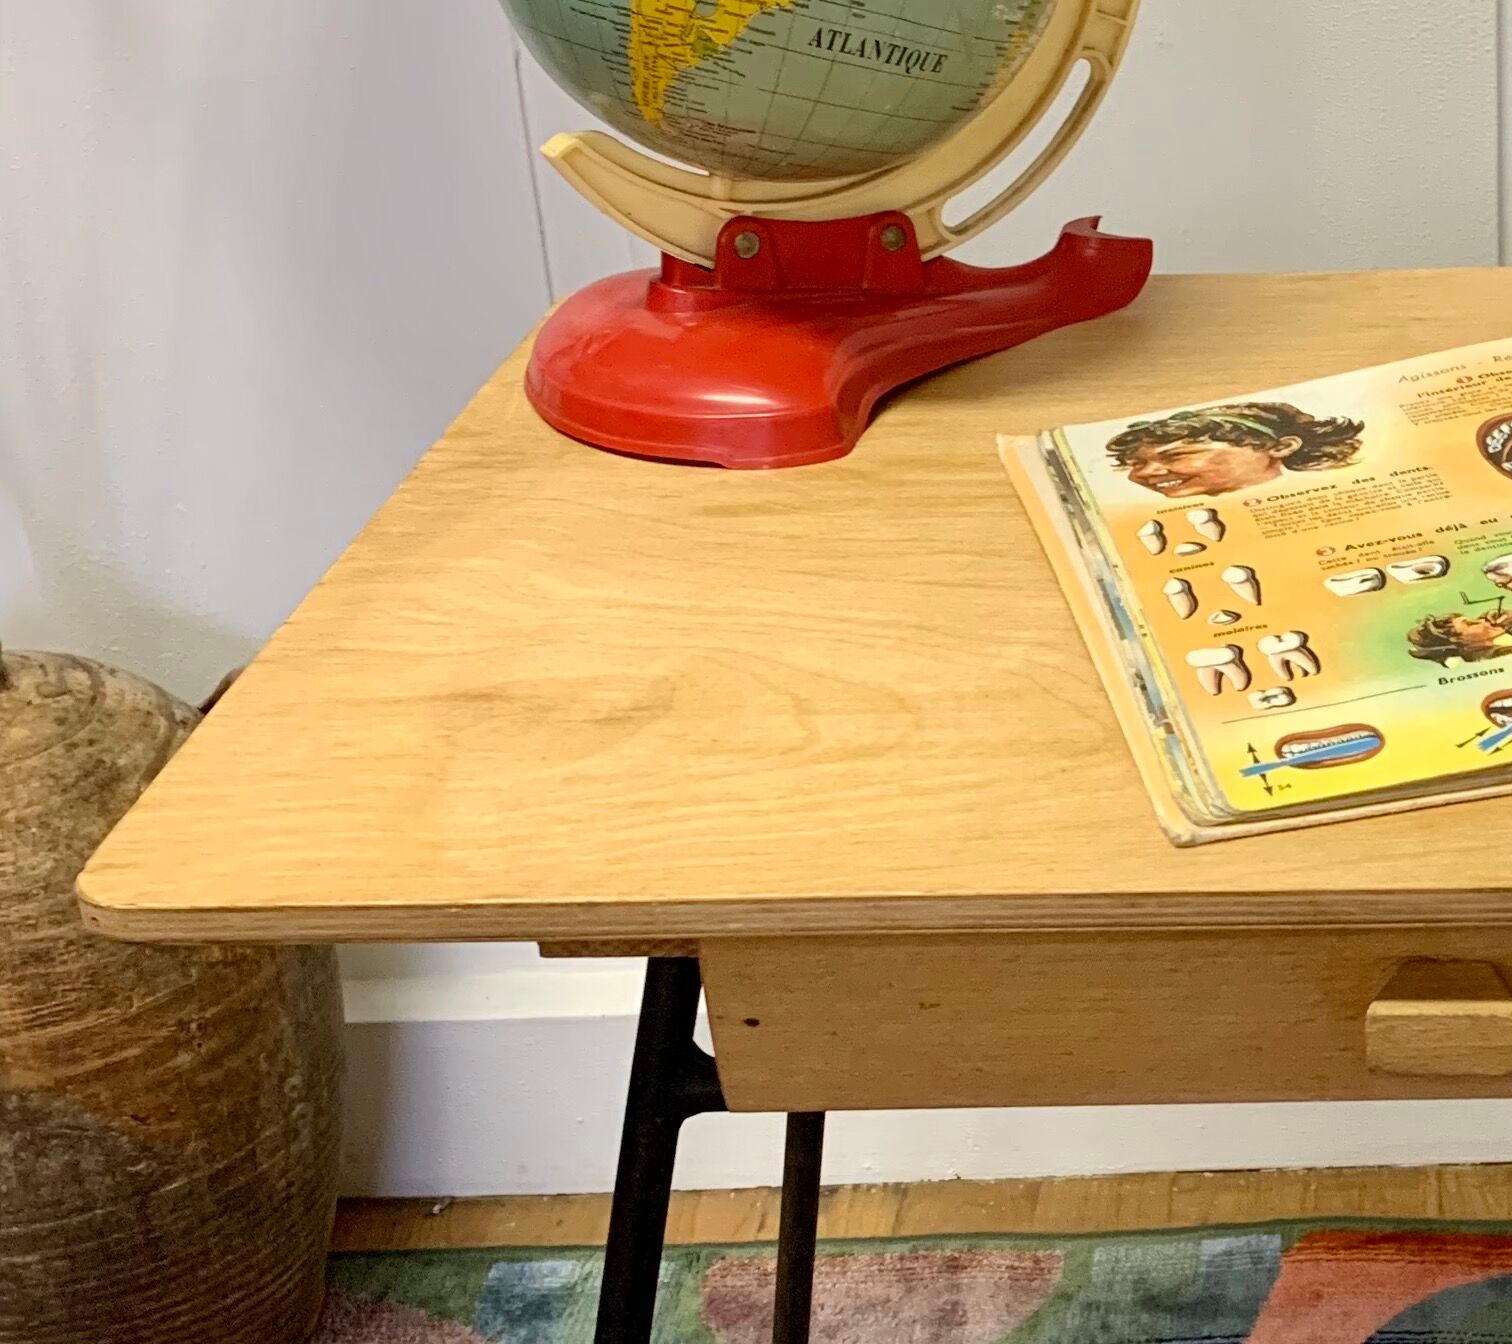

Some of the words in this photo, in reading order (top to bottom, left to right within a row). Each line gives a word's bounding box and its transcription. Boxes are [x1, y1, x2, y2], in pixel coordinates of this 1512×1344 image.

[807, 26, 949, 75] ATLANTIQUE
[1397, 363, 1467, 383] Agissons
[1416, 379, 1487, 398] l'intérieur
[1266, 484, 1337, 502] Observez
[1351, 476, 1376, 485] des
[1388, 465, 1433, 477] dents.
[1344, 532, 1423, 551] Avez-vous
[1434, 522, 1468, 533] déjà
[1479, 517, 1498, 525] eu
[1169, 561, 1214, 574] canines
[1212, 622, 1268, 638] molaires
[1437, 665, 1504, 686] Brossons
